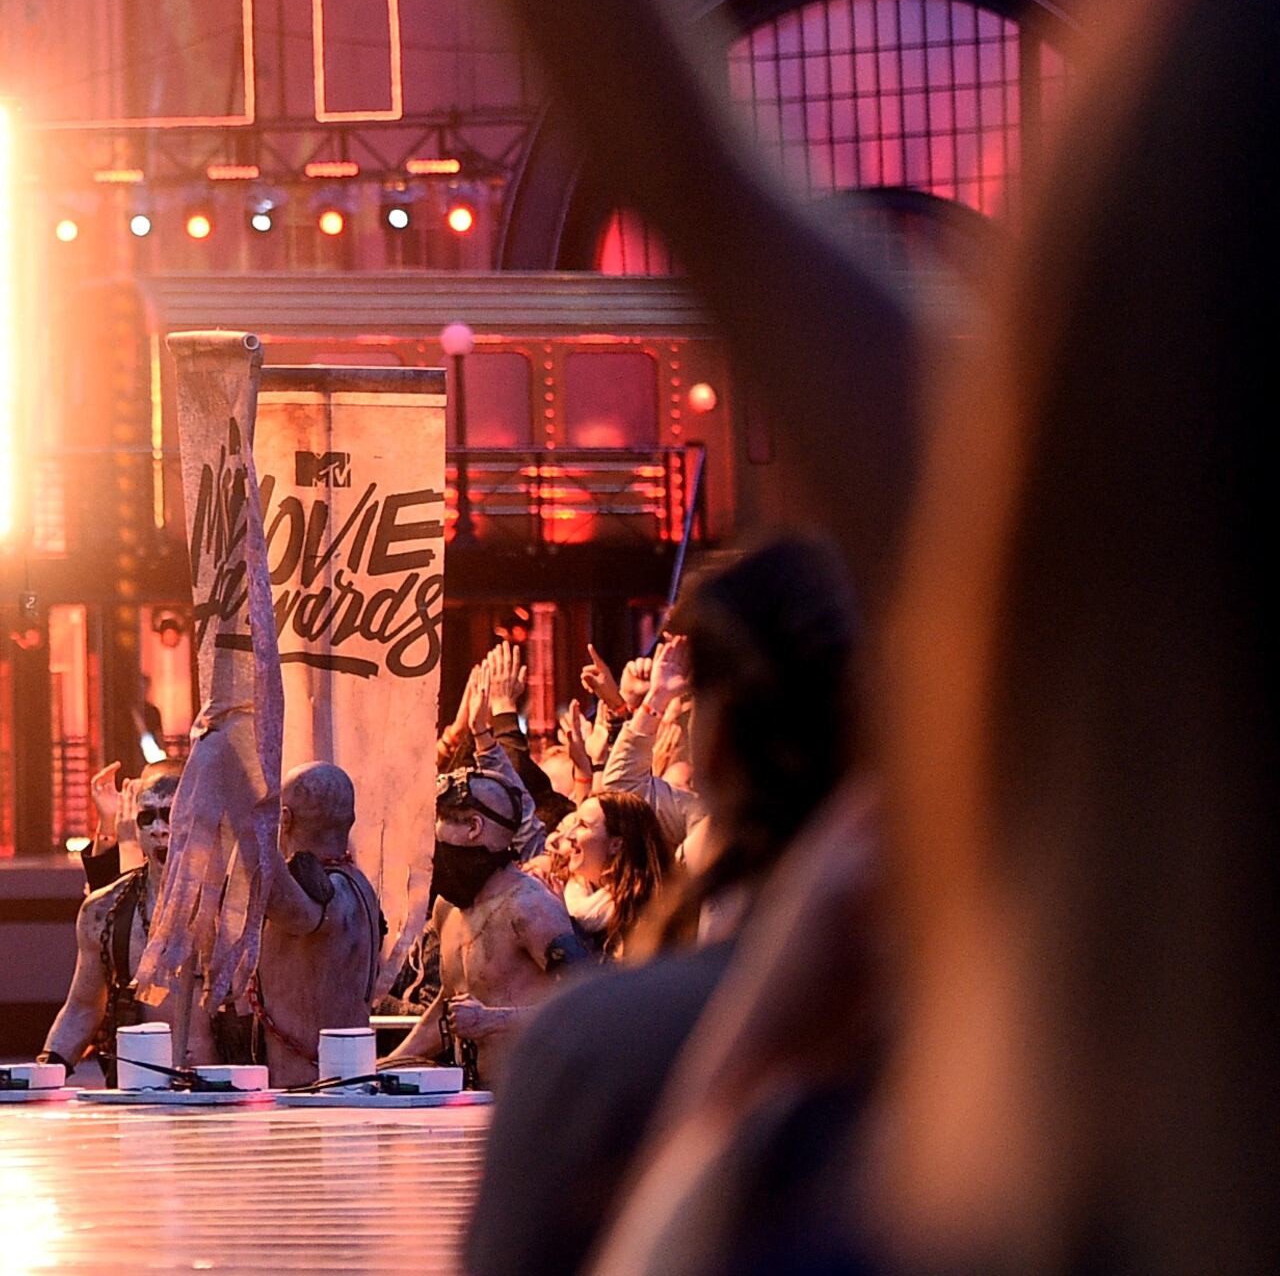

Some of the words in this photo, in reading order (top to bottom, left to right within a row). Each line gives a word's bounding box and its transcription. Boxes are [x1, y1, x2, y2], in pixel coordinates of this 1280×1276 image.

[295, 450, 352, 488] MTV
[259, 474, 445, 588] OVIE
[273, 572, 443, 679] ards
